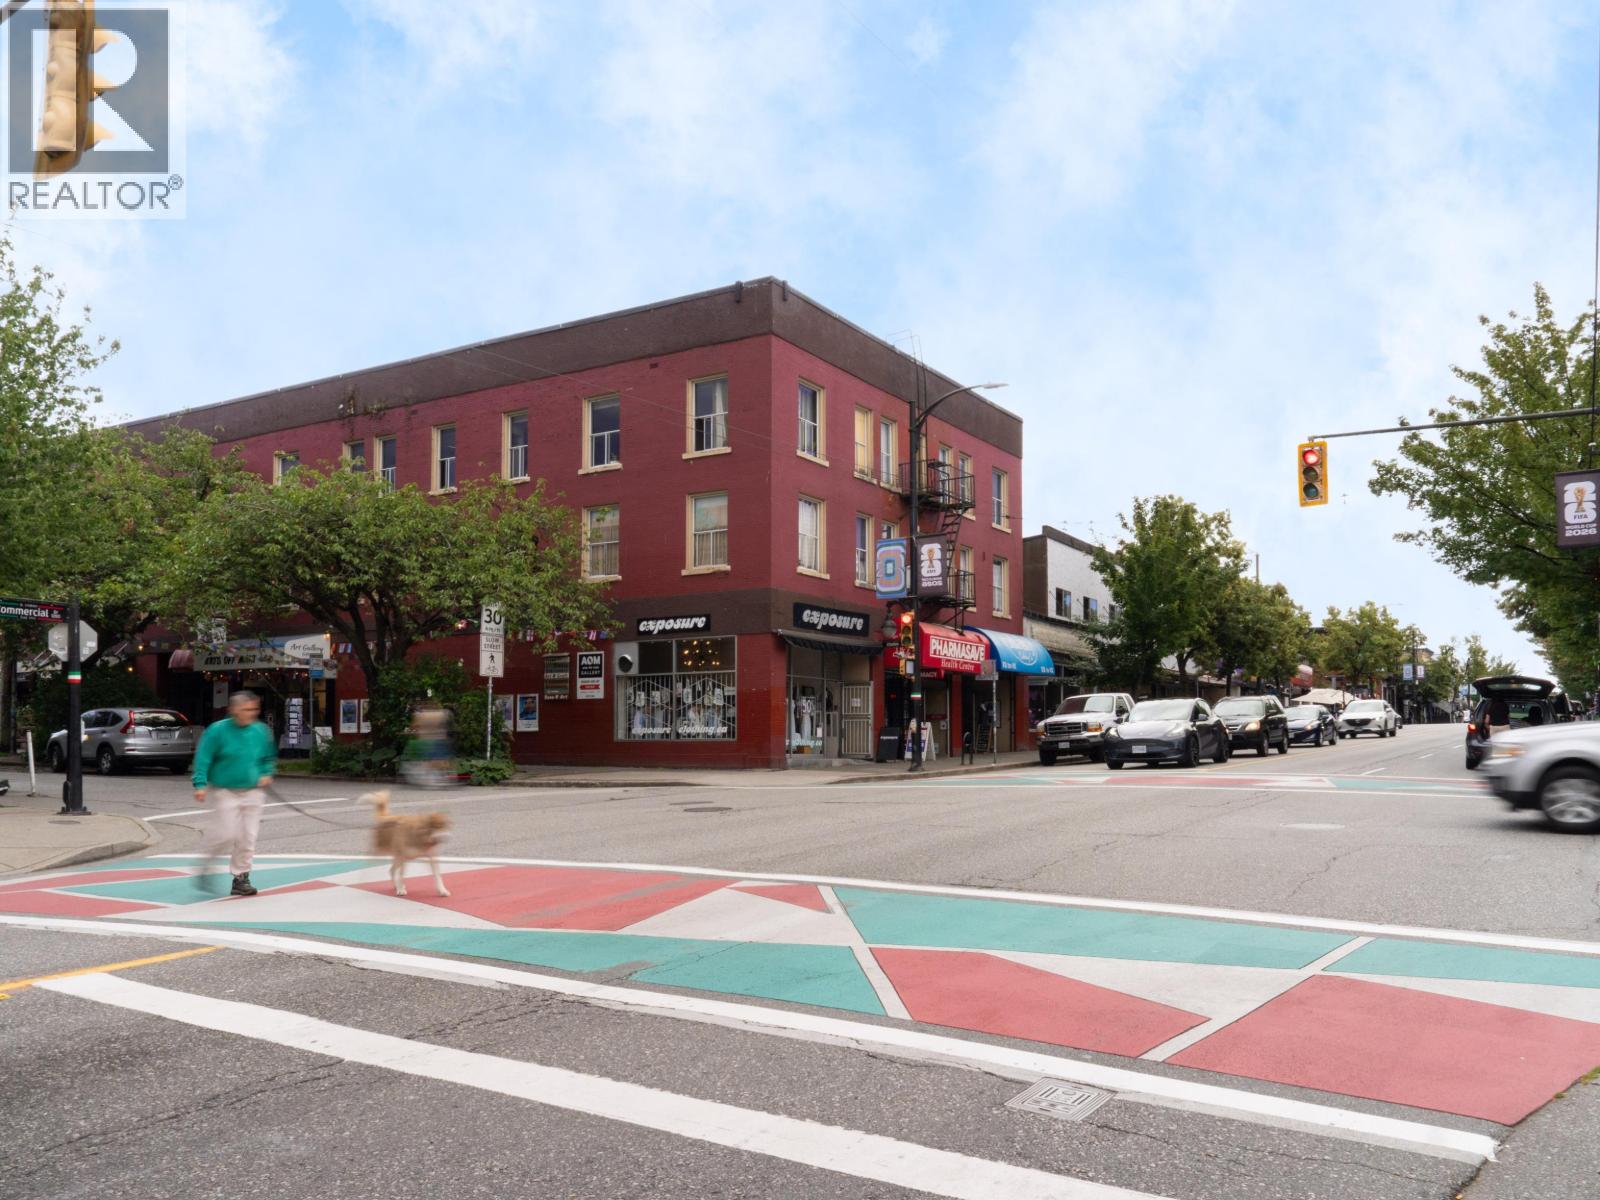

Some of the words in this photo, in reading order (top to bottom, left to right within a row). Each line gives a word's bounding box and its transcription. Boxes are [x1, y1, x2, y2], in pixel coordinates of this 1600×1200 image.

[1565, 528, 1597, 536] 2026
[0, 606, 49, 618] ommercial
[484, 608, 502, 625] 30
[639, 616, 706, 634] exposure
[802, 609, 864, 630] exposure
[290, 643, 301, 651] Art
[930, 638, 985, 661] PHARMASAVE
[581, 655, 601, 666] AOM
[941, 659, 958, 669] Health
